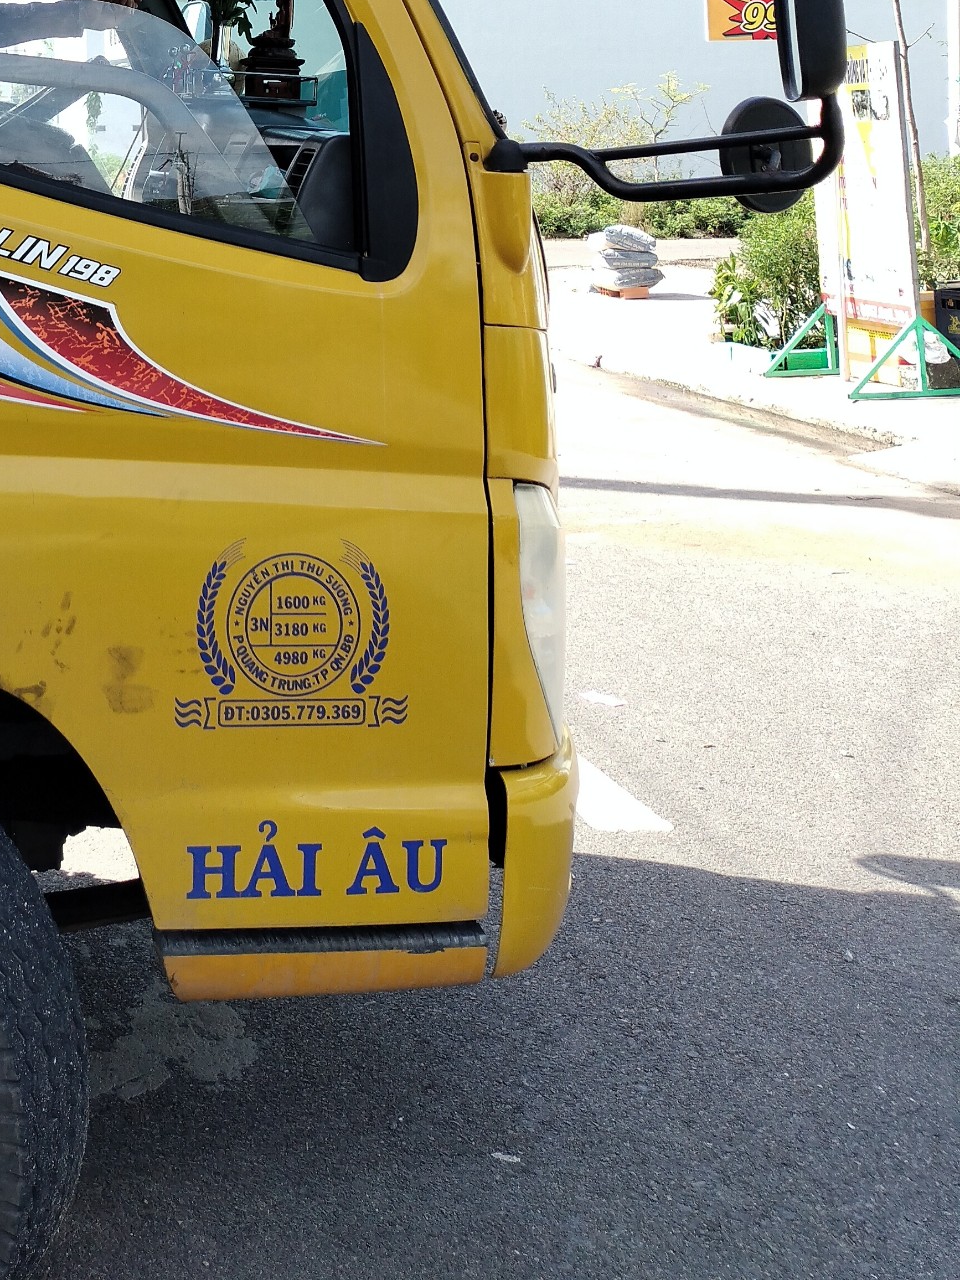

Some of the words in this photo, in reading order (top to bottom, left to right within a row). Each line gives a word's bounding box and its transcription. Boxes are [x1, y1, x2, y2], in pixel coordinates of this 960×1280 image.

[58, 254, 122, 288] 198
[299, 560, 324, 577] THU
[276, 595, 310, 609] 1600
[312, 595, 327, 606] KG
[250, 617, 269, 632] 3N
[274, 622, 309, 637] 3180
[312, 622, 327, 633] KG
[236, 645, 269, 684] QUANG
[273, 650, 308, 665] 4980
[312, 648, 326, 659] KG
[223, 703, 362, 721] ĐT:0305.779.369
[186, 819, 323, 899] HẢI
[346, 825, 448, 896] ÂU
